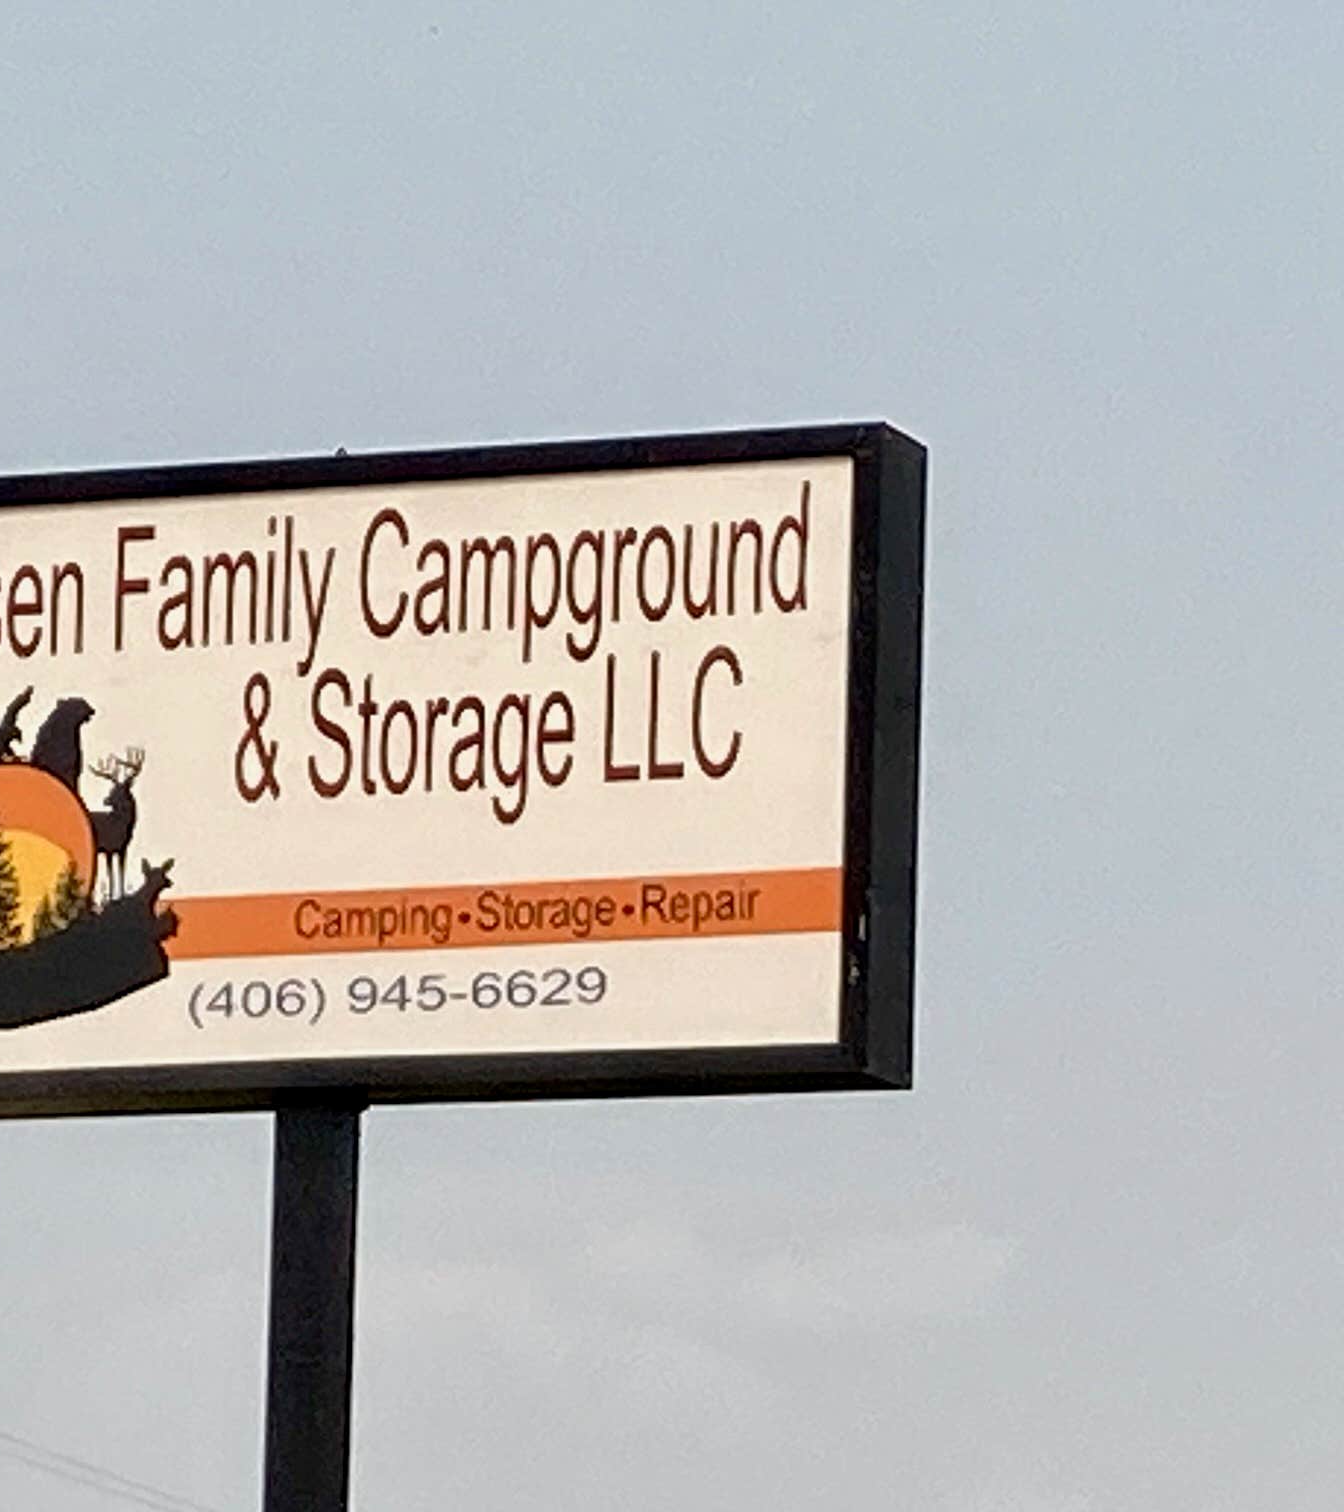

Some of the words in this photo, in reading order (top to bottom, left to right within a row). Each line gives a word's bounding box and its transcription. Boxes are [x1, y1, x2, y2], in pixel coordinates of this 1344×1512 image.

[113, 515, 338, 677] Family
[360, 481, 811, 662] Campground
[234, 672, 282, 803] &
[307, 667, 576, 825] Storage
[602, 644, 744, 783] LLC
[187, 978, 327, 1029] (406)
[347, 966, 608, 1015] 945-6629
